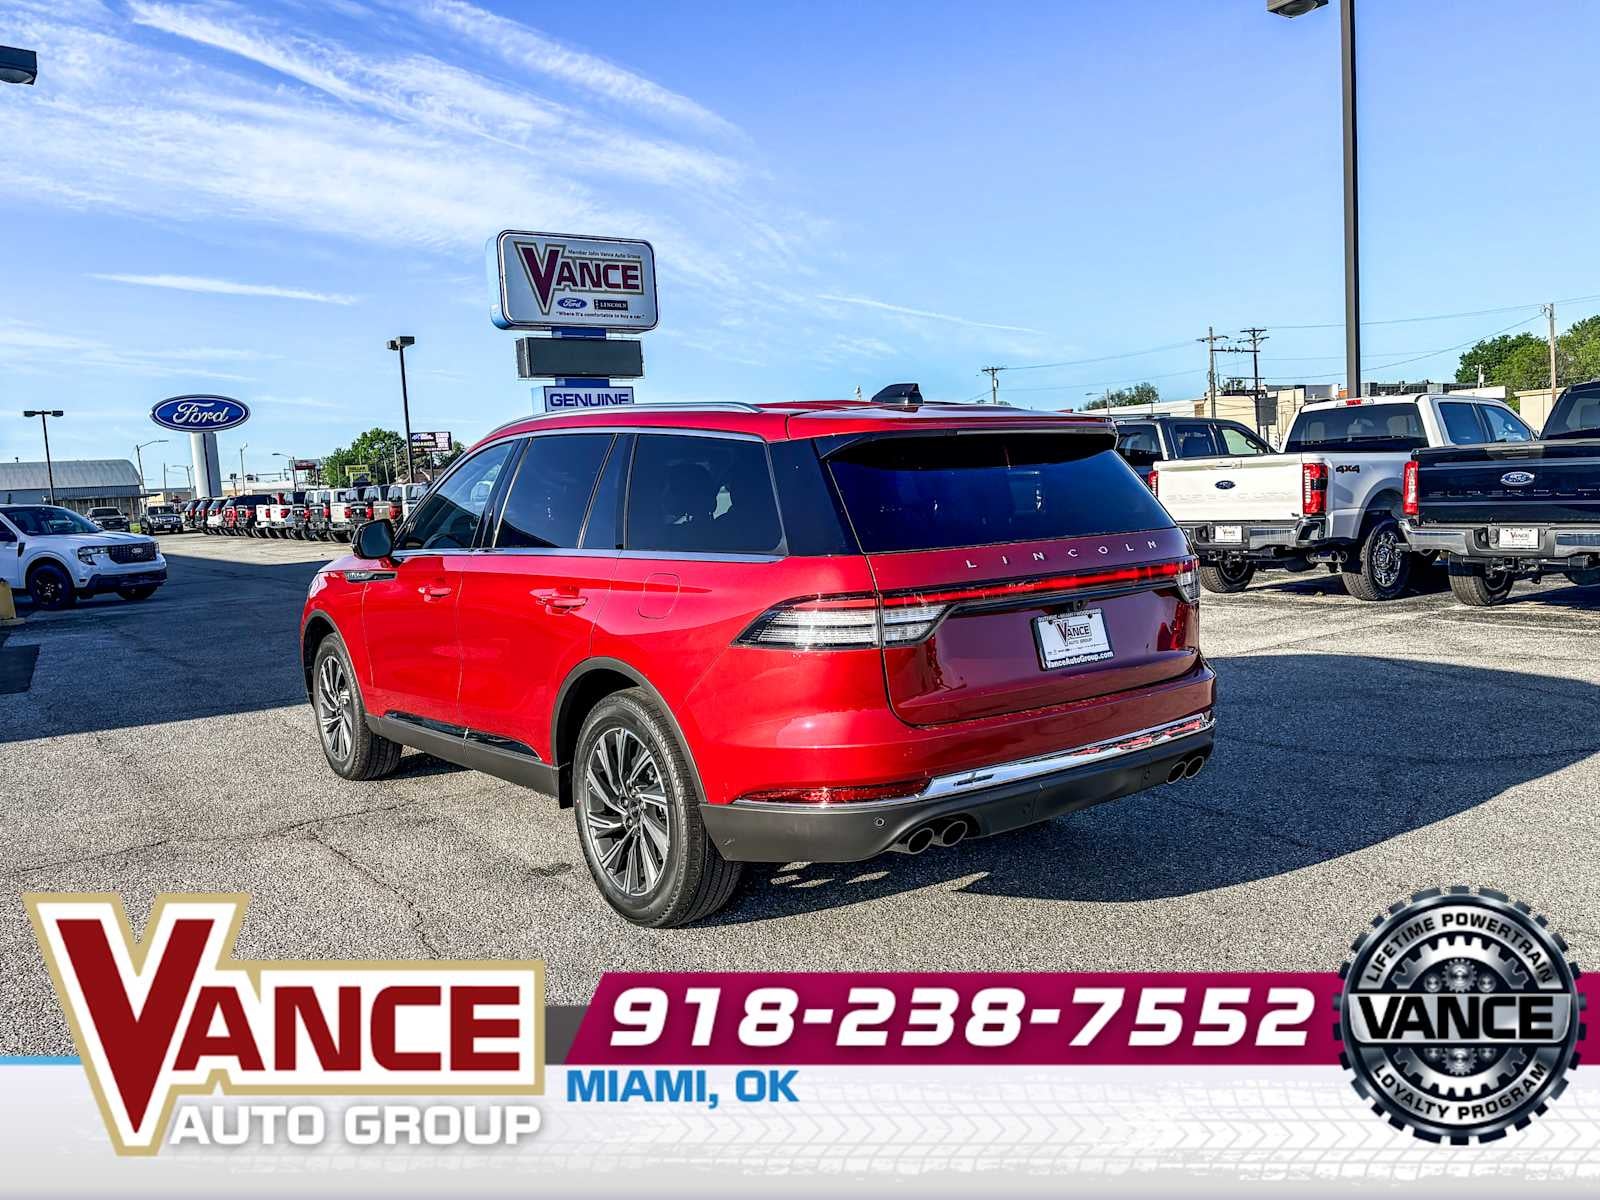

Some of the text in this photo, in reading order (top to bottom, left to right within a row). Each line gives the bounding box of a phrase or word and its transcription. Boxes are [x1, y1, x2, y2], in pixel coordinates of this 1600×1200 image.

[519, 246, 640, 311] VANCE
[562, 298, 582, 308] Ford
[549, 393, 630, 408] GENUINE
[172, 401, 230, 424] Ford
[966, 540, 1163, 569] LINCOLN
[1056, 621, 1091, 643] VANCE
[1046, 651, 1114, 668] VanceAutoGroup.com
